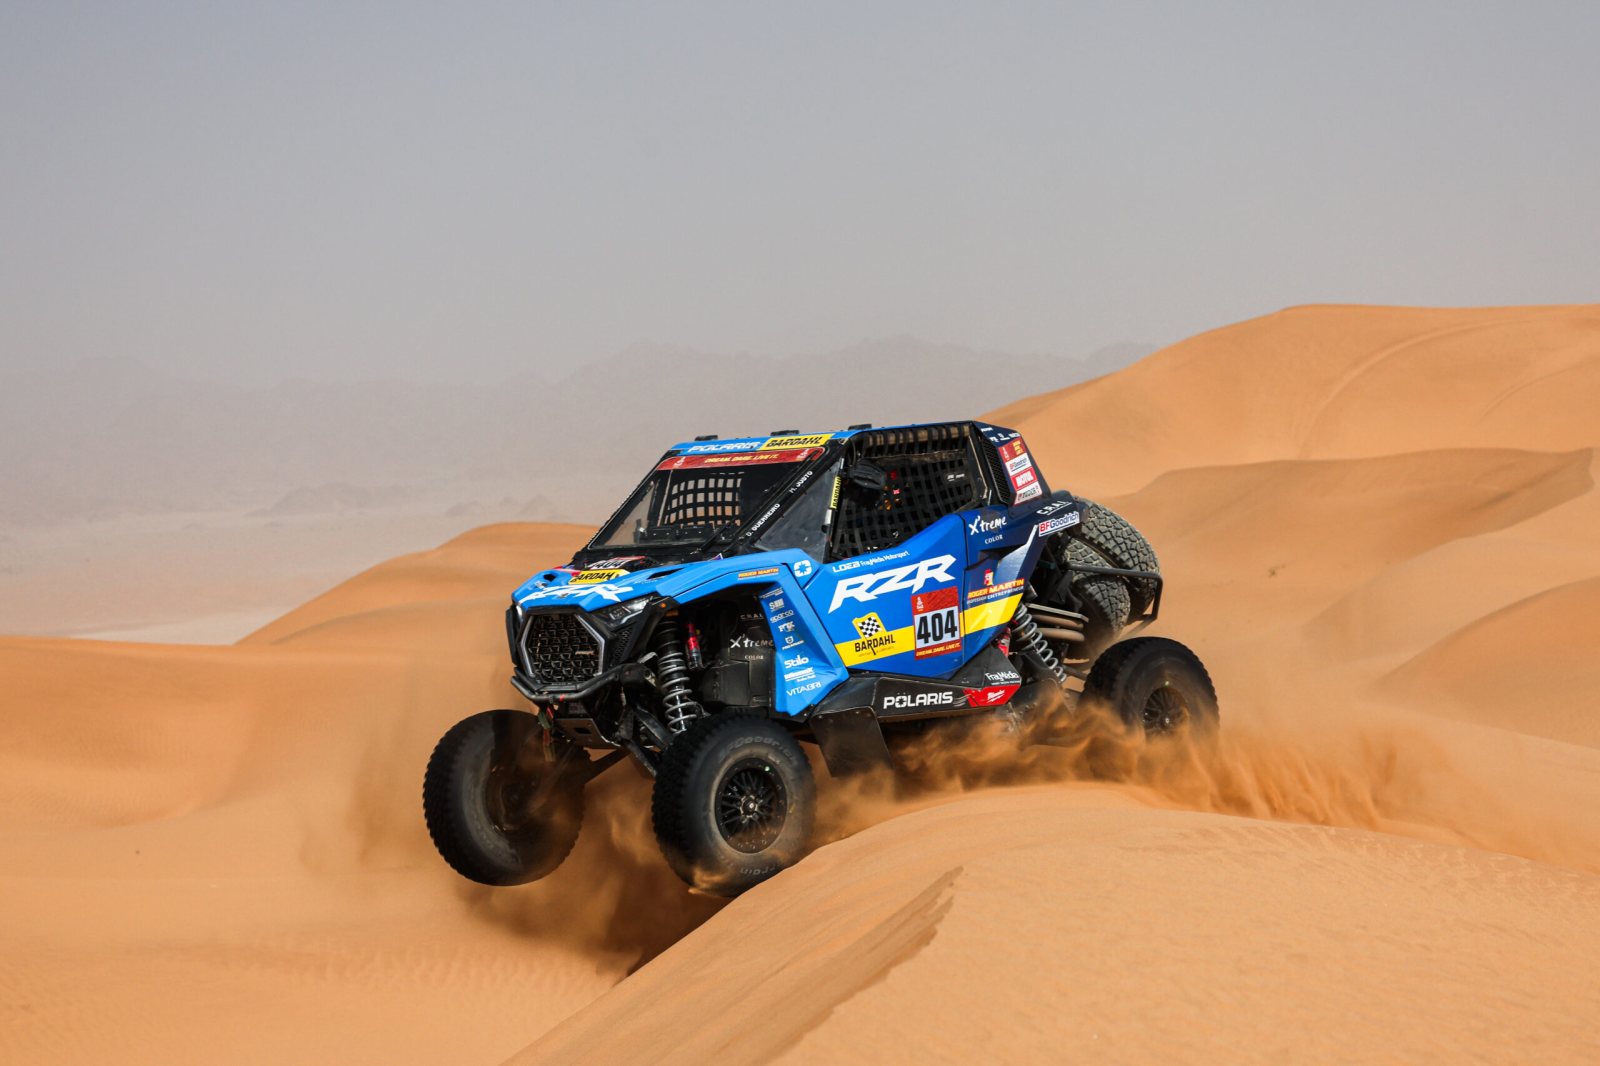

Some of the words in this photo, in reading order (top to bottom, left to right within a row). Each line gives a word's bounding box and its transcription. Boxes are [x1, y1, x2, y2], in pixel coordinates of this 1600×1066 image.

[687, 441, 762, 453] POLARIS
[765, 435, 823, 448] BARDAHL
[1039, 511, 1080, 532] BFGoodrich
[984, 534, 1003, 545] COLOR
[832, 560, 861, 573] LOEB
[827, 554, 957, 614] RZR
[967, 587, 988, 599] ROGER
[988, 578, 1025, 594] MARTIN
[916, 610, 958, 644] 404
[854, 634, 896, 653] BARDAHL
[784, 654, 809, 669] Stilo
[883, 691, 954, 709] POLARIS
